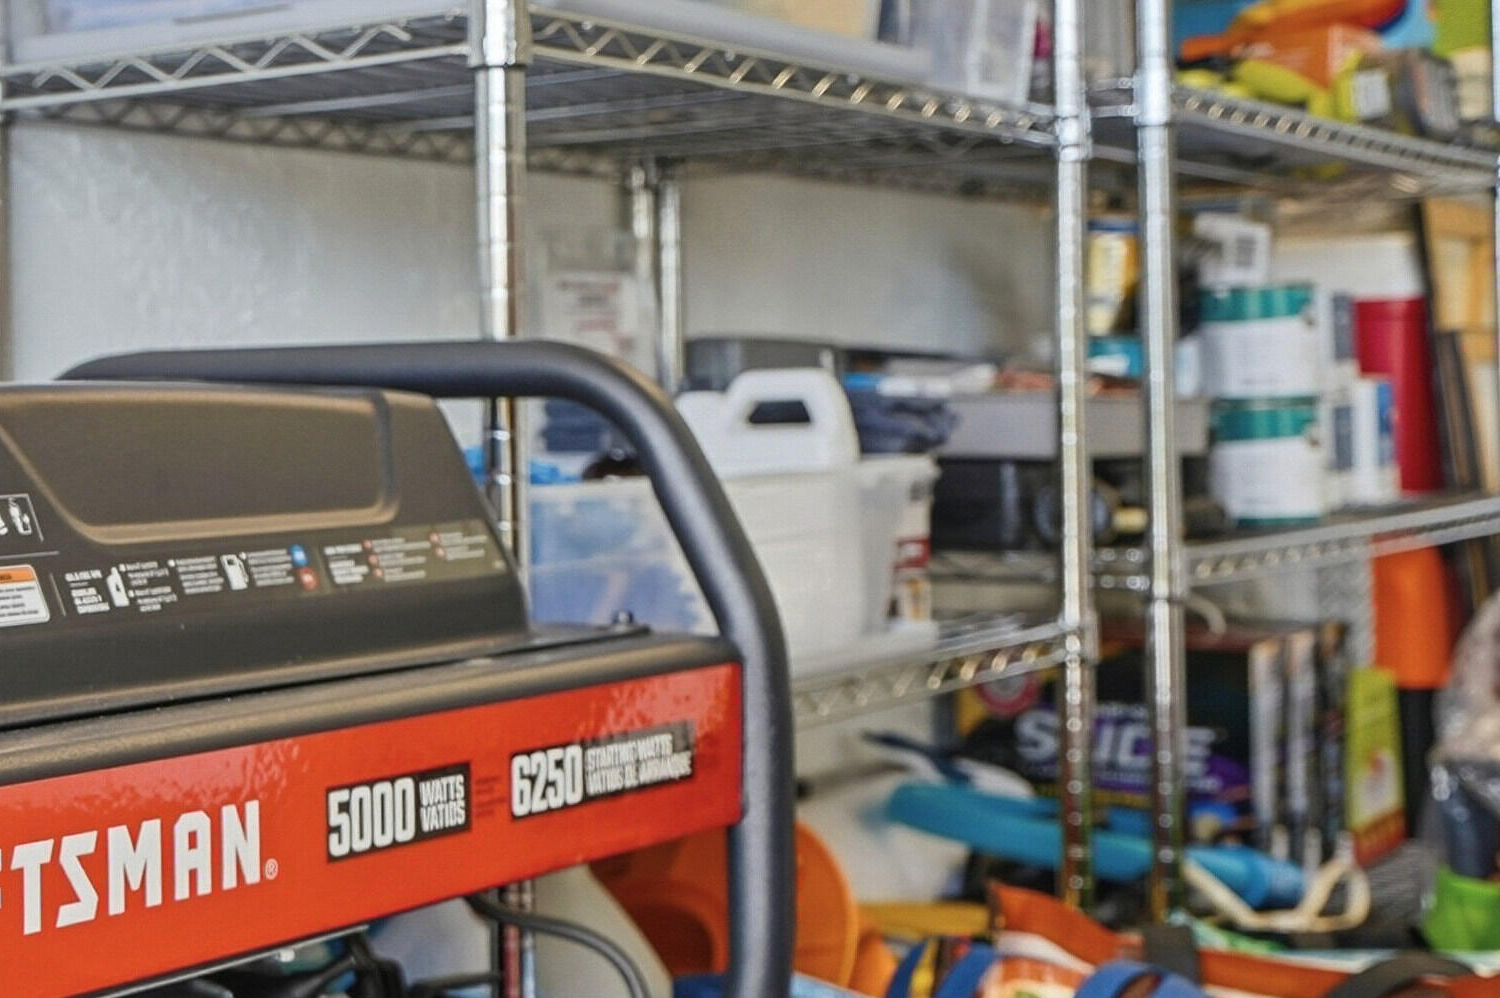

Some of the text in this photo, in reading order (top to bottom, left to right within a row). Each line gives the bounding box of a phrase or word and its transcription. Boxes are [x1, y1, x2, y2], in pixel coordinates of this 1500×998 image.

[328, 777, 416, 857] 5000
[419, 774, 465, 806] WATTS
[511, 744, 584, 818] 6250
